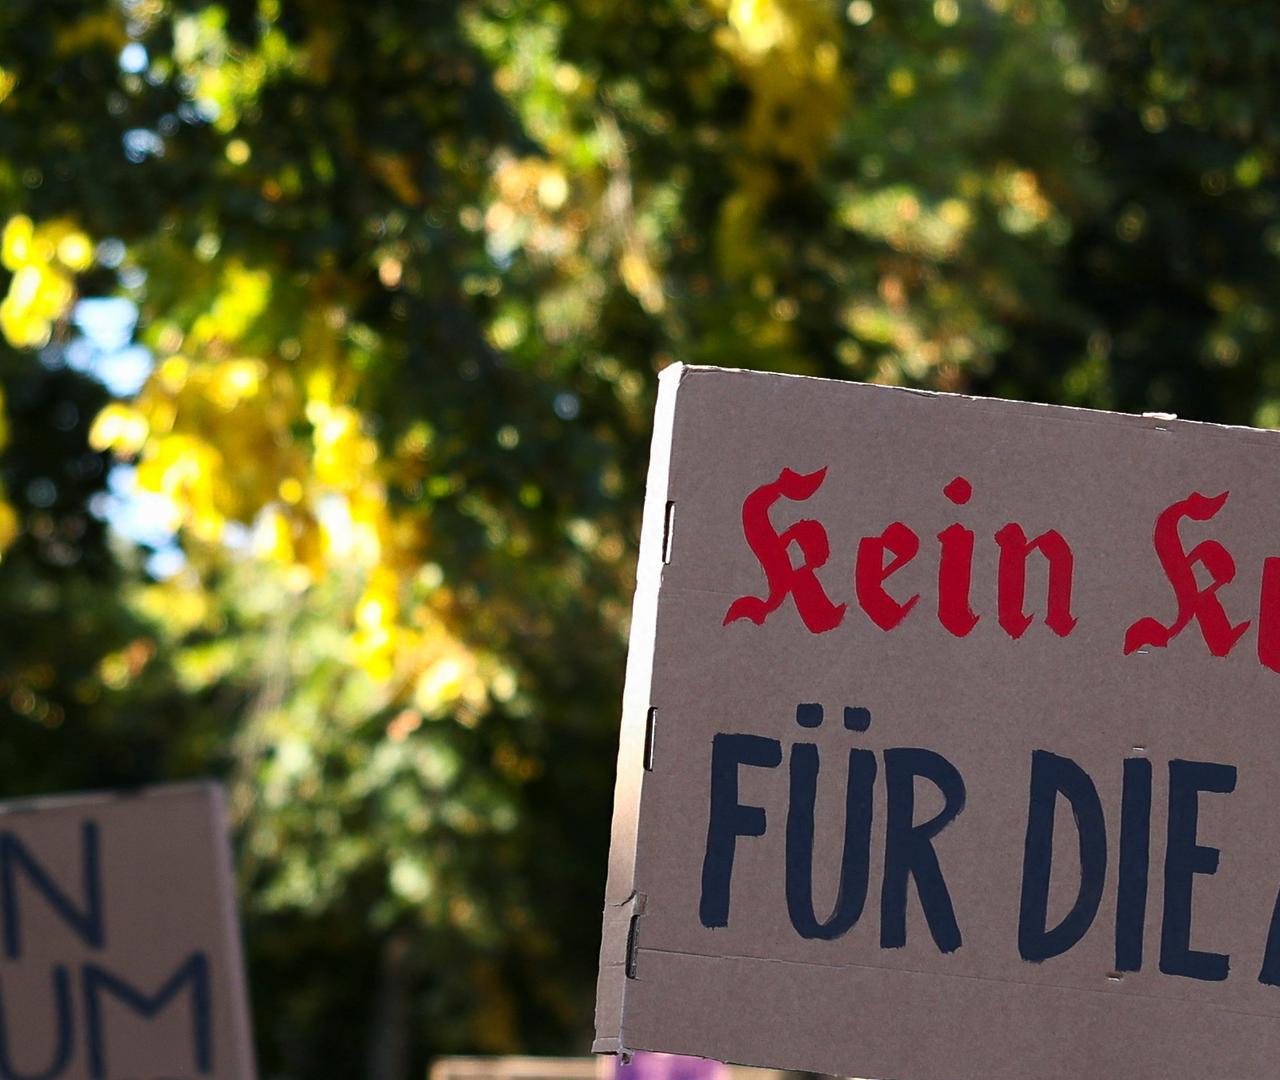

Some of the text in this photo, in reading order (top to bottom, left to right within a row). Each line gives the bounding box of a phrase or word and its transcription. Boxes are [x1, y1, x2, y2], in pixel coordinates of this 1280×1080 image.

[725, 466, 1078, 640] Kein
[699, 702, 967, 955] FÜR
[1017, 749, 1239, 982] DIE
